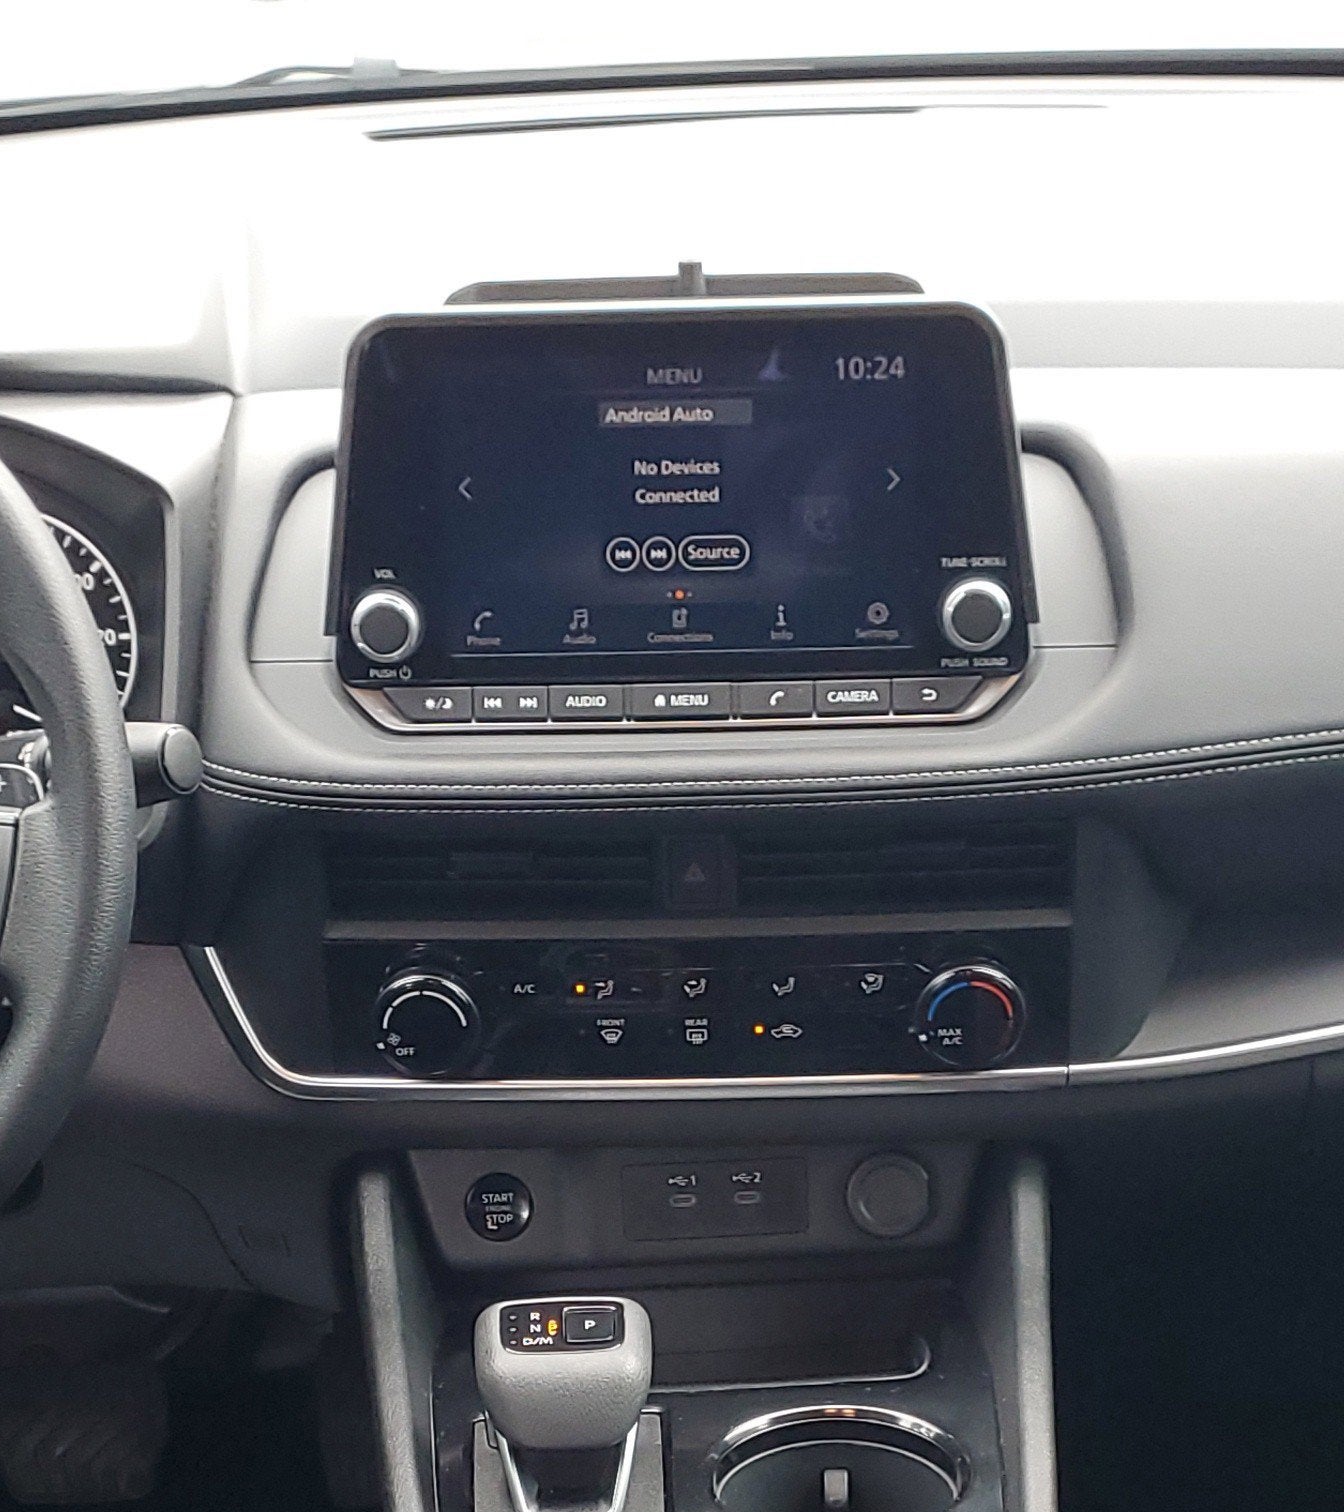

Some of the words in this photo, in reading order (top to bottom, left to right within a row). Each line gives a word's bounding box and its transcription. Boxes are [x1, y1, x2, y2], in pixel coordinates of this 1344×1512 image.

[836, 356, 905, 380] 10:24
[646, 367, 703, 385] MENU
[605, 406, 670, 424] Android
[672, 406, 714, 423] Auto
[633, 460, 658, 475] No
[661, 459, 721, 475] Devices
[634, 486, 721, 503] Connected
[687, 544, 741, 560] Source
[369, 668, 398, 680] PUSH
[565, 695, 606, 708] AUDIO
[670, 692, 708, 707] MENU
[827, 689, 879, 703] CAMERA
[514, 983, 536, 995] A/C
[937, 1028, 963, 1038] MAX
[942, 1037, 963, 1046] A/C
[395, 1047, 415, 1057] OFF
[481, 1193, 514, 1204] START
[486, 1213, 513, 1224] STOP
[530, 1312, 540, 1321] R
[530, 1324, 541, 1333] N
[584, 1320, 596, 1330] P
[522, 1337, 553, 1346] D/M
